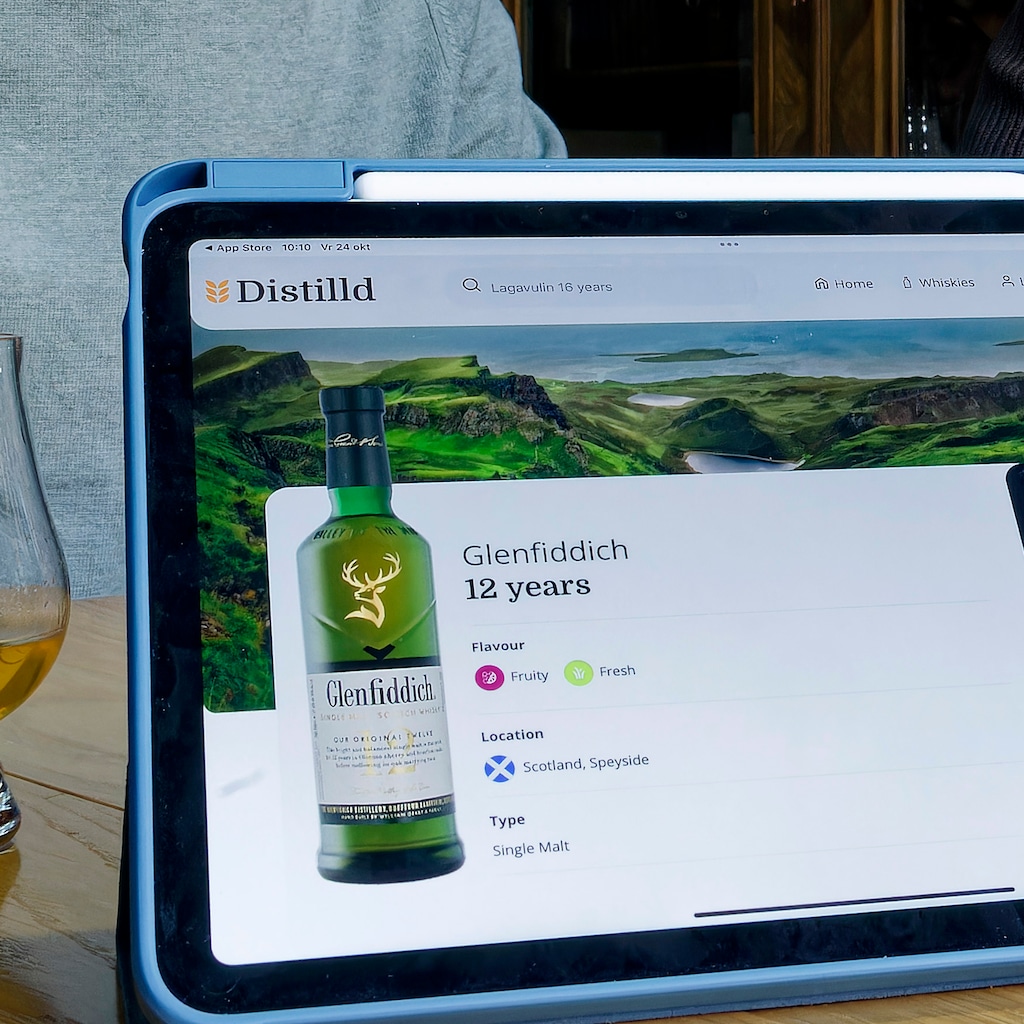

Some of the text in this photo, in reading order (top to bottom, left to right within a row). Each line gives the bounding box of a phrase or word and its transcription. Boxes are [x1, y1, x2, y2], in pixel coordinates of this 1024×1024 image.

[217, 242, 371, 253] App Store 10:10 Vr 24 okt
[491, 281, 613, 294] Lagavulin 16 years
[834, 277, 873, 289] Home
[918, 276, 975, 289] Whiskies
[236, 276, 376, 304] Distilld
[463, 539, 629, 566] Glenfiddich
[464, 577, 591, 603] 12 years
[472, 641, 525, 653] Flavour
[511, 670, 549, 683] Fruity
[600, 664, 636, 677] Fresh
[326, 675, 434, 708] Glenfiddich
[333, 736, 349, 744] OUR
[481, 729, 544, 742] Location
[523, 754, 649, 773] Scotland, Speyside
[489, 815, 525, 829] Type
[493, 840, 570, 858] Single Malt
